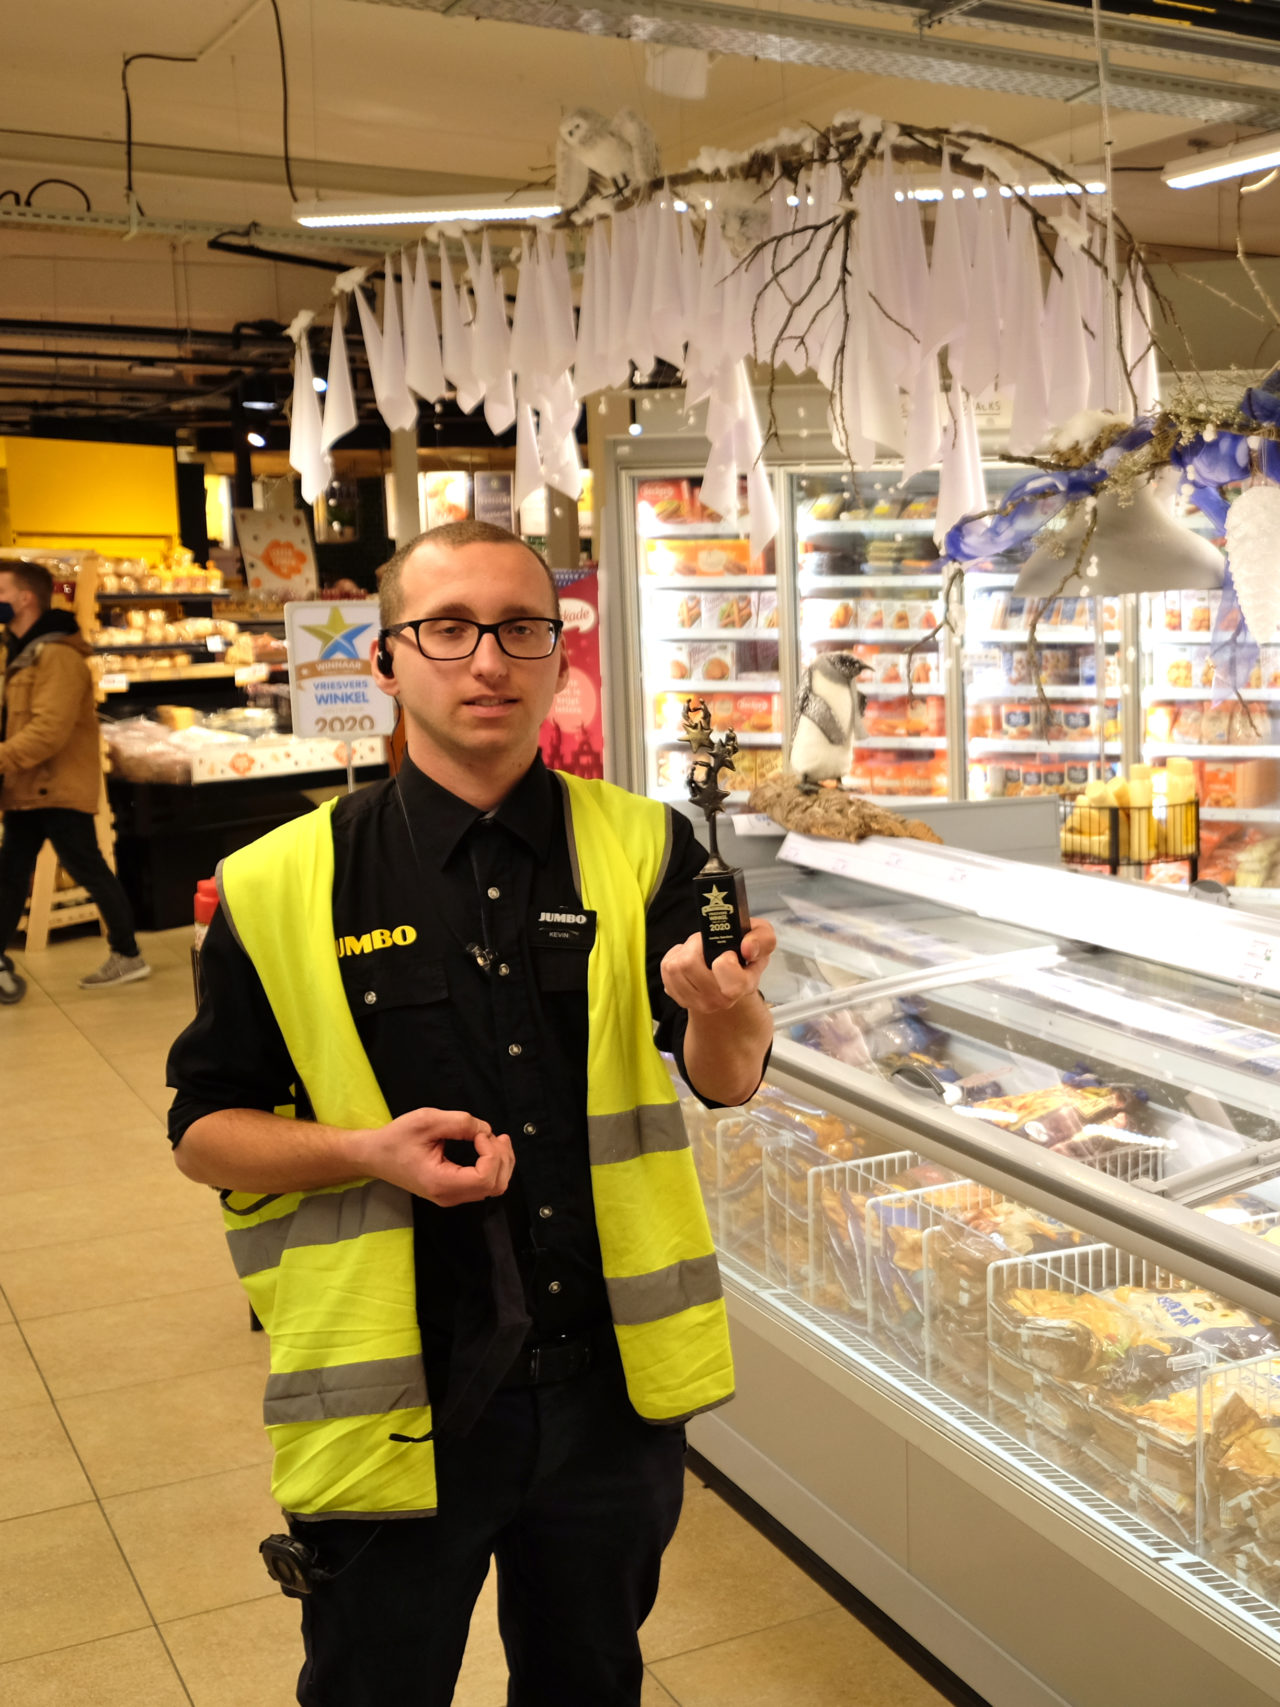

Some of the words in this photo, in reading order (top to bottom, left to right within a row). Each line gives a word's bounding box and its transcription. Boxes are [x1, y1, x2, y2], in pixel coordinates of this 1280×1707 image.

[313, 680, 368, 690] VRIESVERS
[315, 691, 369, 705] WINKEL
[315, 714, 375, 732] 2020
[538, 911, 587, 925] JUMBO
[709, 922, 731, 931] 2020
[336, 925, 417, 958] UMBO
